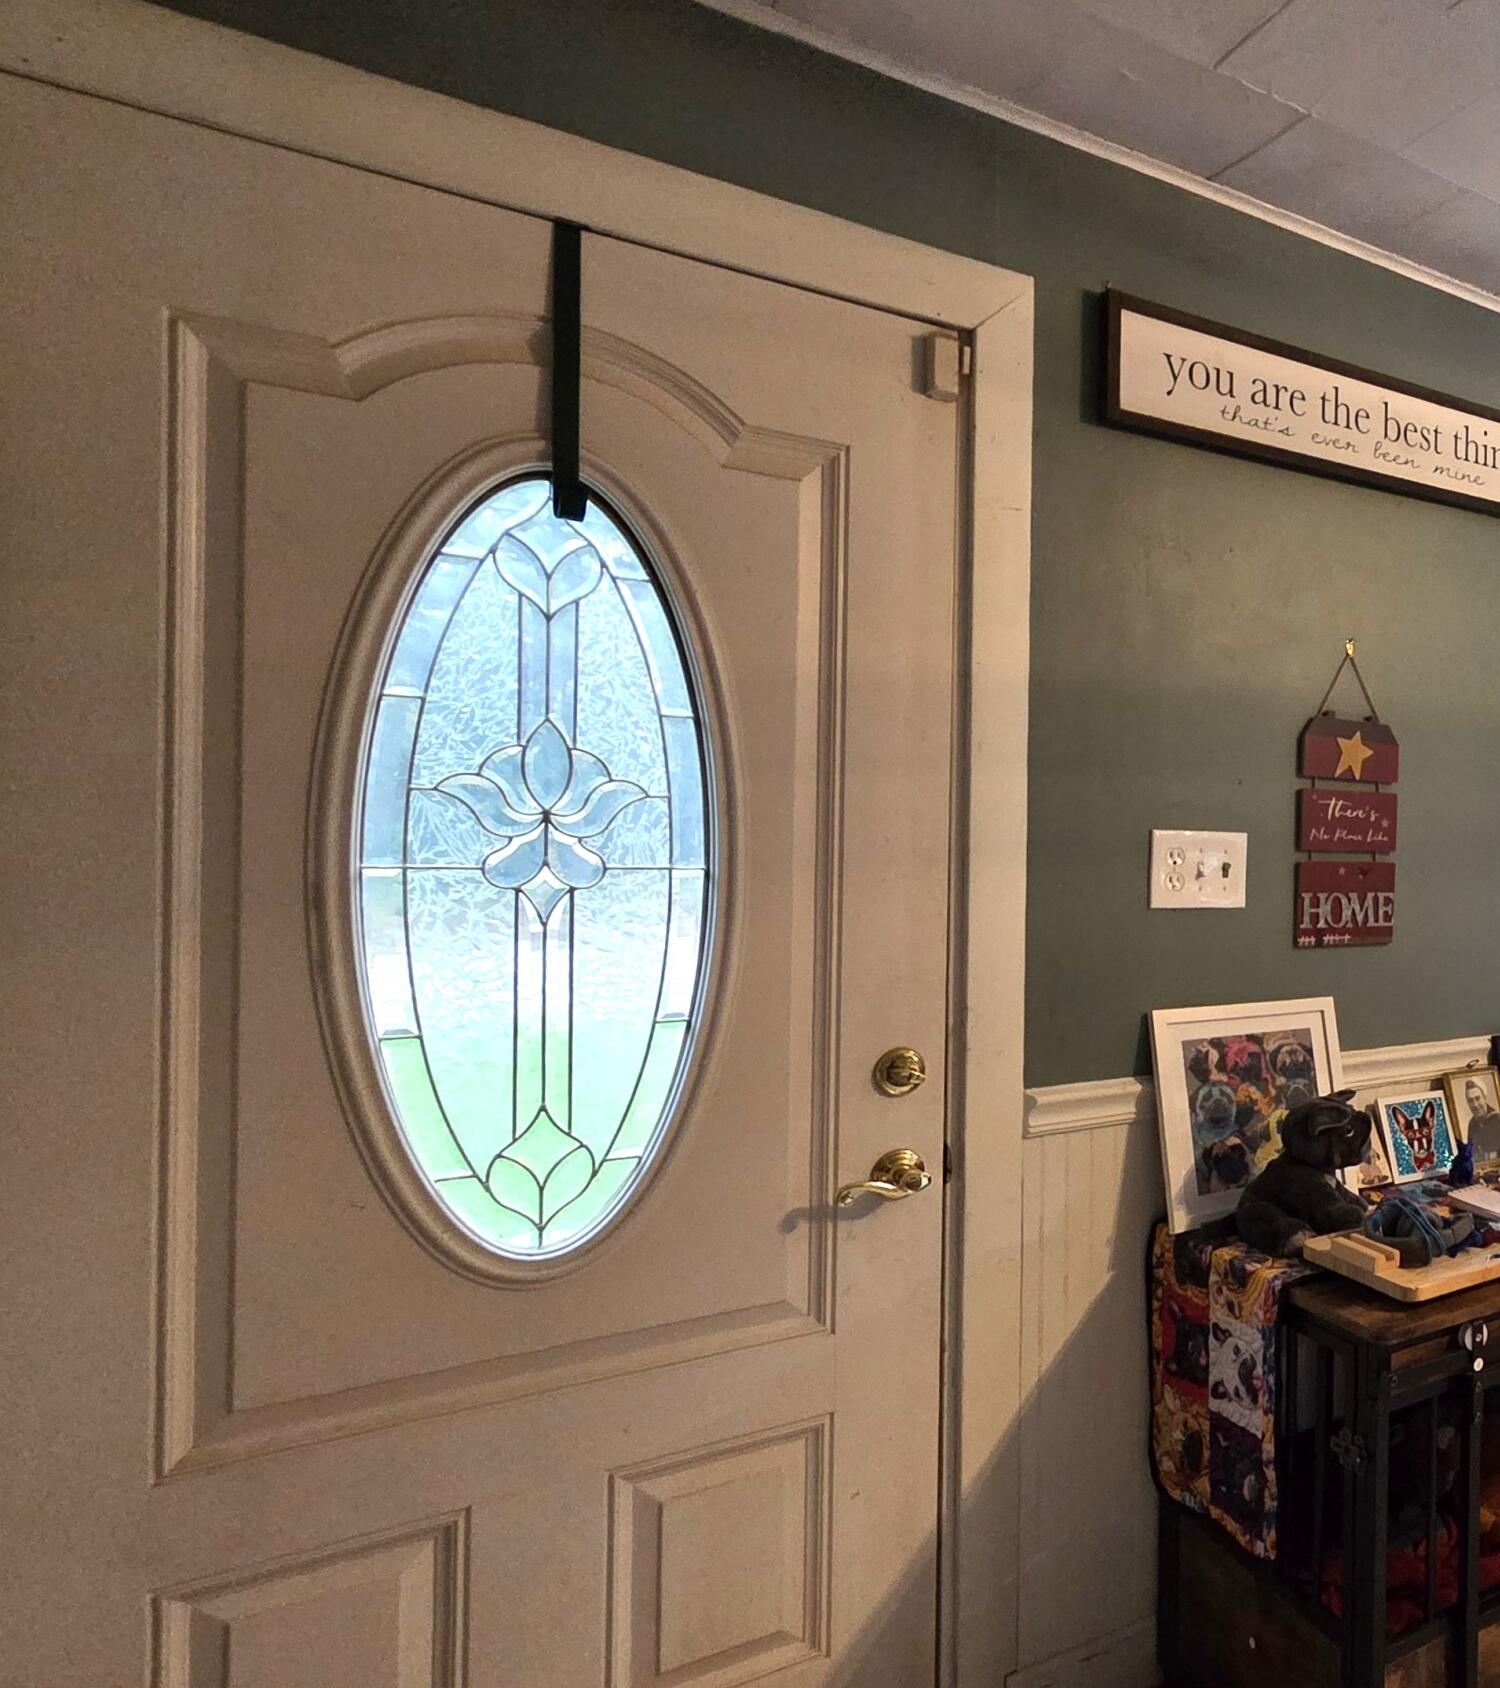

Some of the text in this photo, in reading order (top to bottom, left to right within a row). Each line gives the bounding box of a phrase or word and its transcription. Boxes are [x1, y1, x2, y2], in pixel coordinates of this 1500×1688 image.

[1163, 352, 1236, 398] you
[1251, 378, 1306, 417] are
[1320, 386, 1370, 434] the
[1383, 401, 1442, 454] best
[1220, 405, 1486, 486] that's ever been mine
[1318, 797, 1380, 822] There's
[1309, 827, 1330, 841] No
[1299, 892, 1395, 929] HOME
